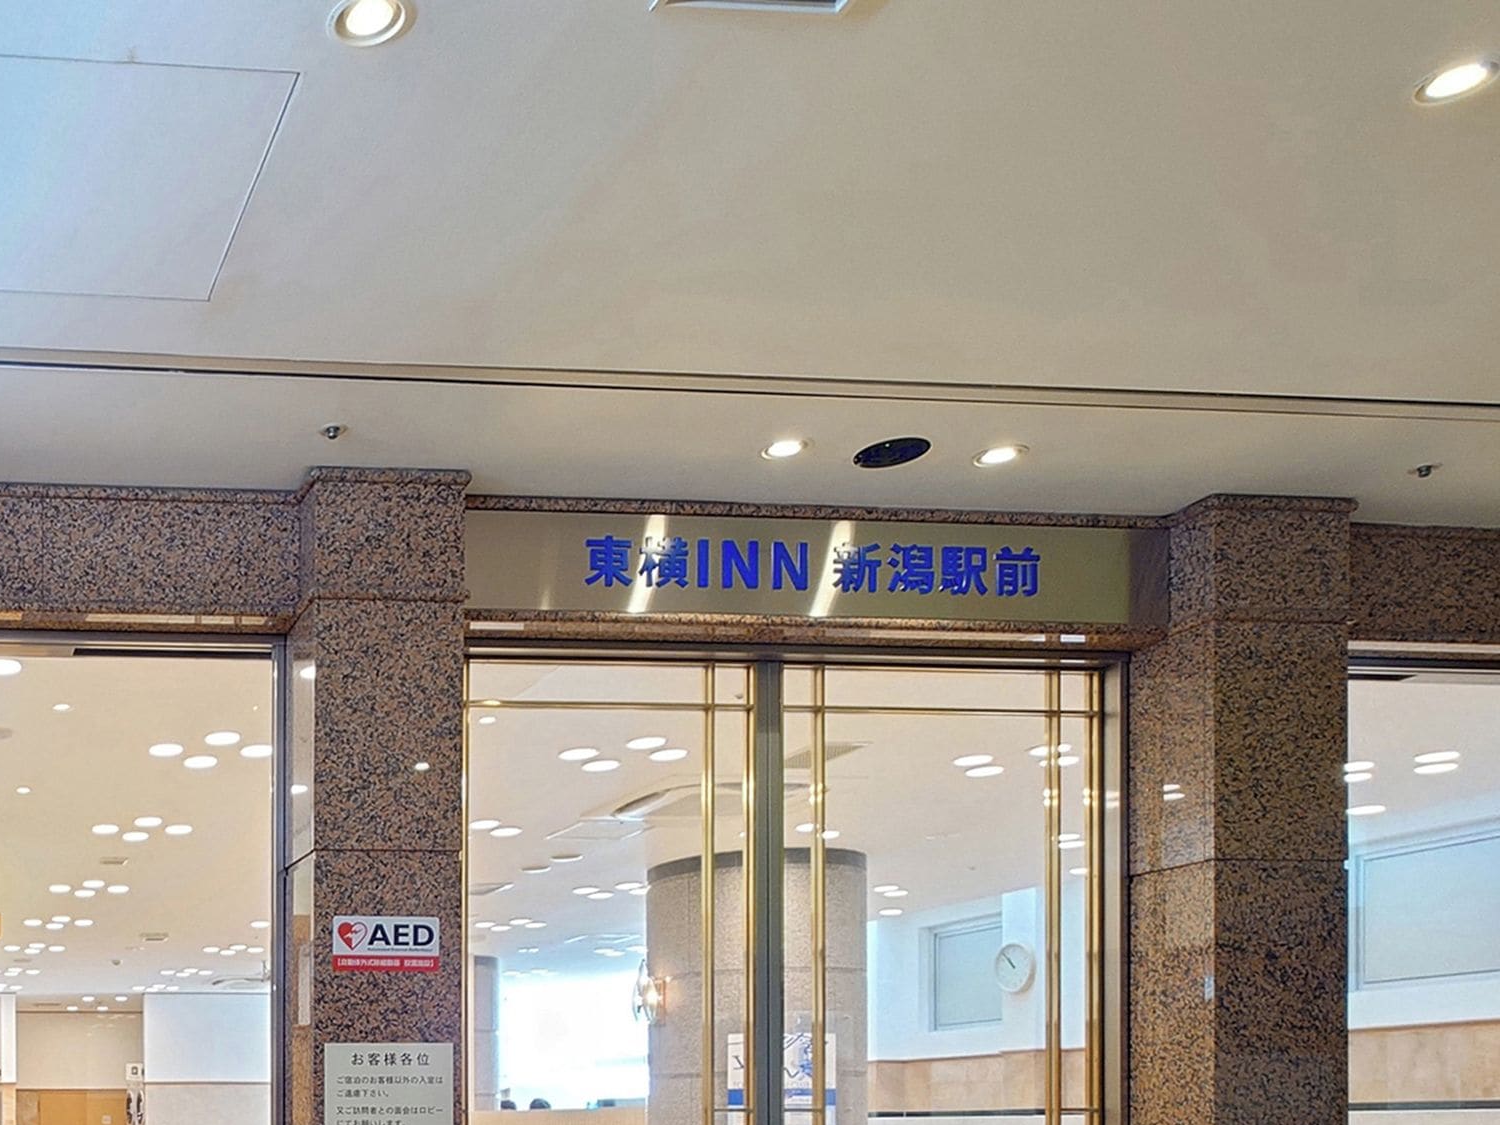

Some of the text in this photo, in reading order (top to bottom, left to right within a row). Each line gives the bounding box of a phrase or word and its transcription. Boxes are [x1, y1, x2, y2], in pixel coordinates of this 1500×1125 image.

[583, 534, 1042, 598] 東横INN 新潟駅前
[367, 923, 435, 947] AED
[351, 1052, 431, 1067] お客様各位
